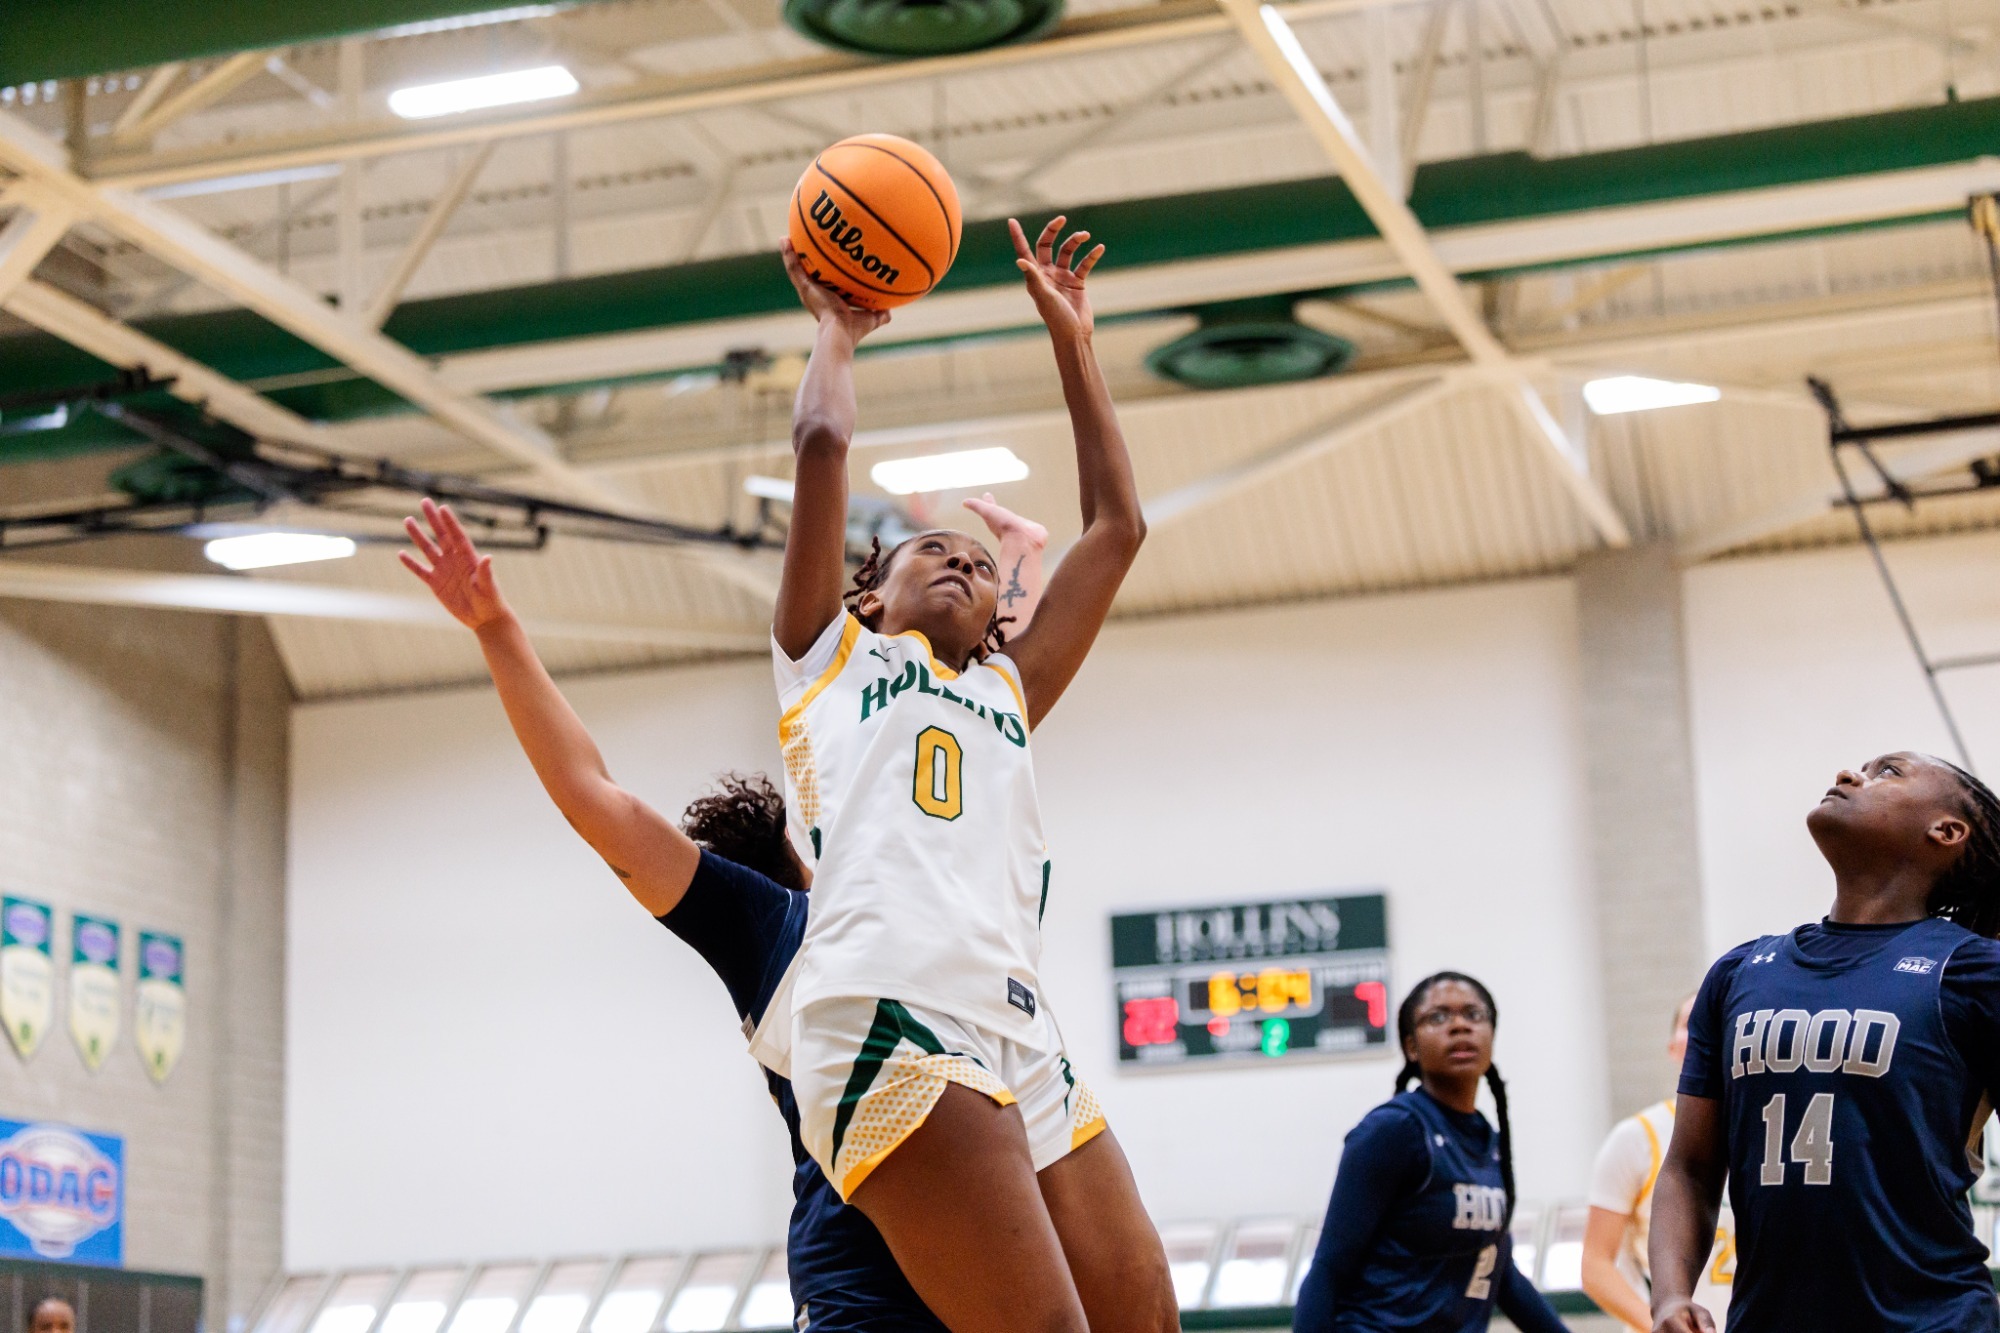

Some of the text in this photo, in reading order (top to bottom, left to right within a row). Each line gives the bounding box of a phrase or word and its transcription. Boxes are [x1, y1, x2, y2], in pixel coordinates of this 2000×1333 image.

[809, 188, 900, 286] Wilson
[911, 724, 963, 822] 0
[1155, 901, 1342, 951] HOLLINS
[1897, 961, 1931, 972] MAC
[1731, 1008, 1901, 1080] HOOD
[1760, 1093, 1835, 1186] 14
[0, 1155, 112, 1216] ODAC
[1465, 1244, 1498, 1300] 2
[1710, 1227, 1737, 1286] 2
